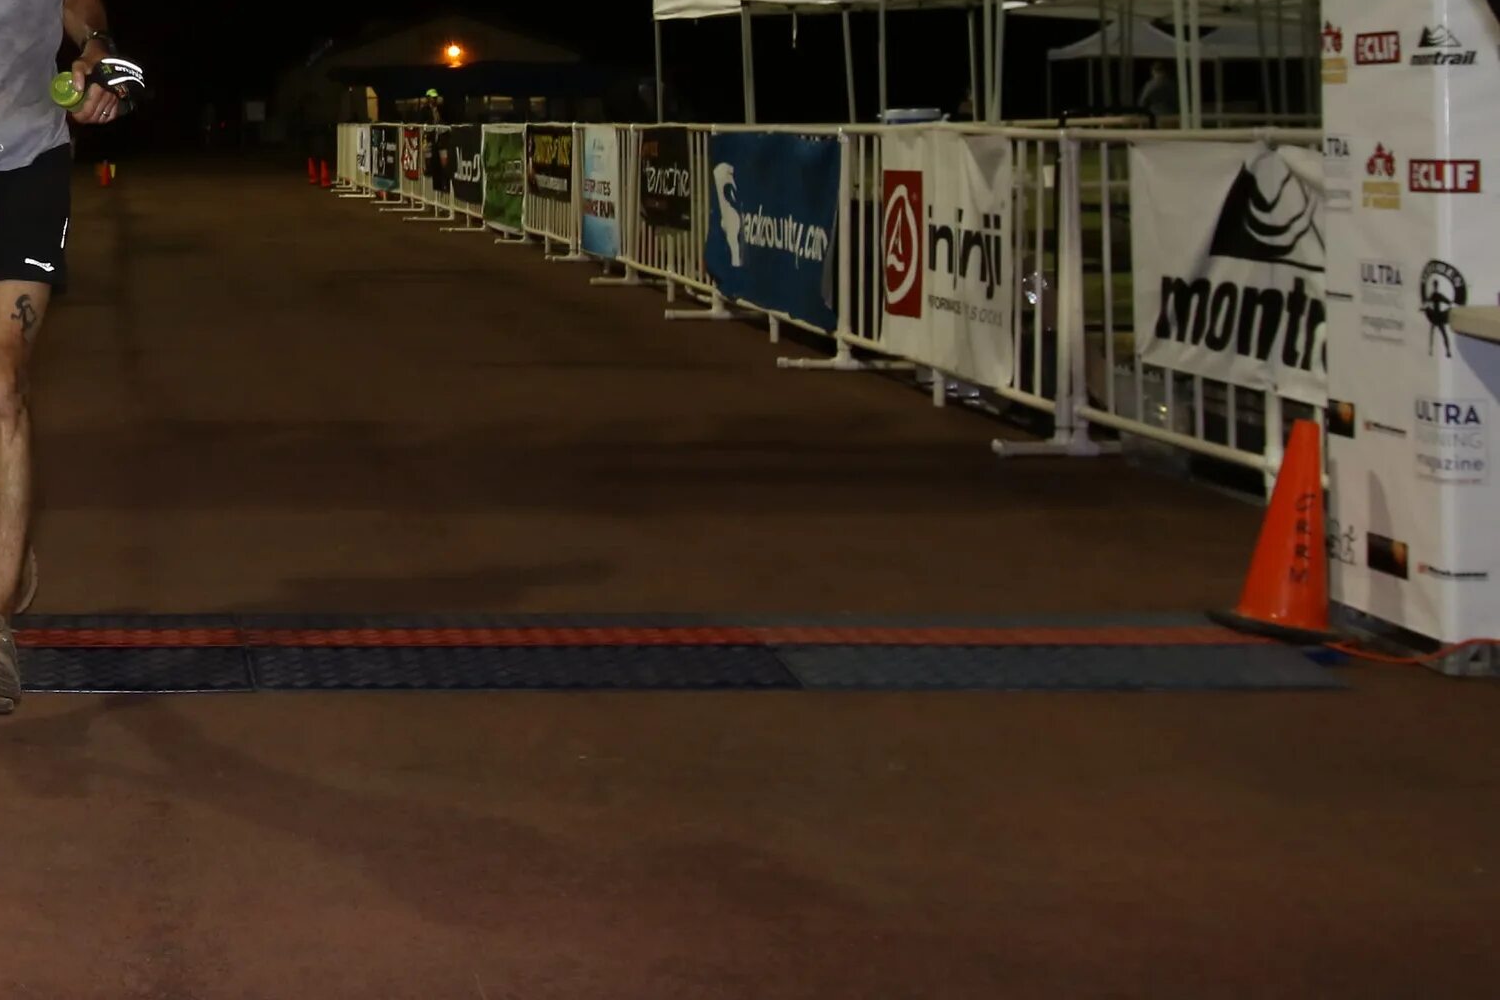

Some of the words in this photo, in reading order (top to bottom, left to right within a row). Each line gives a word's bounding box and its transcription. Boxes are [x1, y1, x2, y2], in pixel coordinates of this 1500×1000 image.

[1364, 35, 1399, 61] CLIF
[1420, 163, 1474, 189] CLIF
[1361, 264, 1403, 286] ULTRA
[1416, 400, 1480, 425] ULTRA
